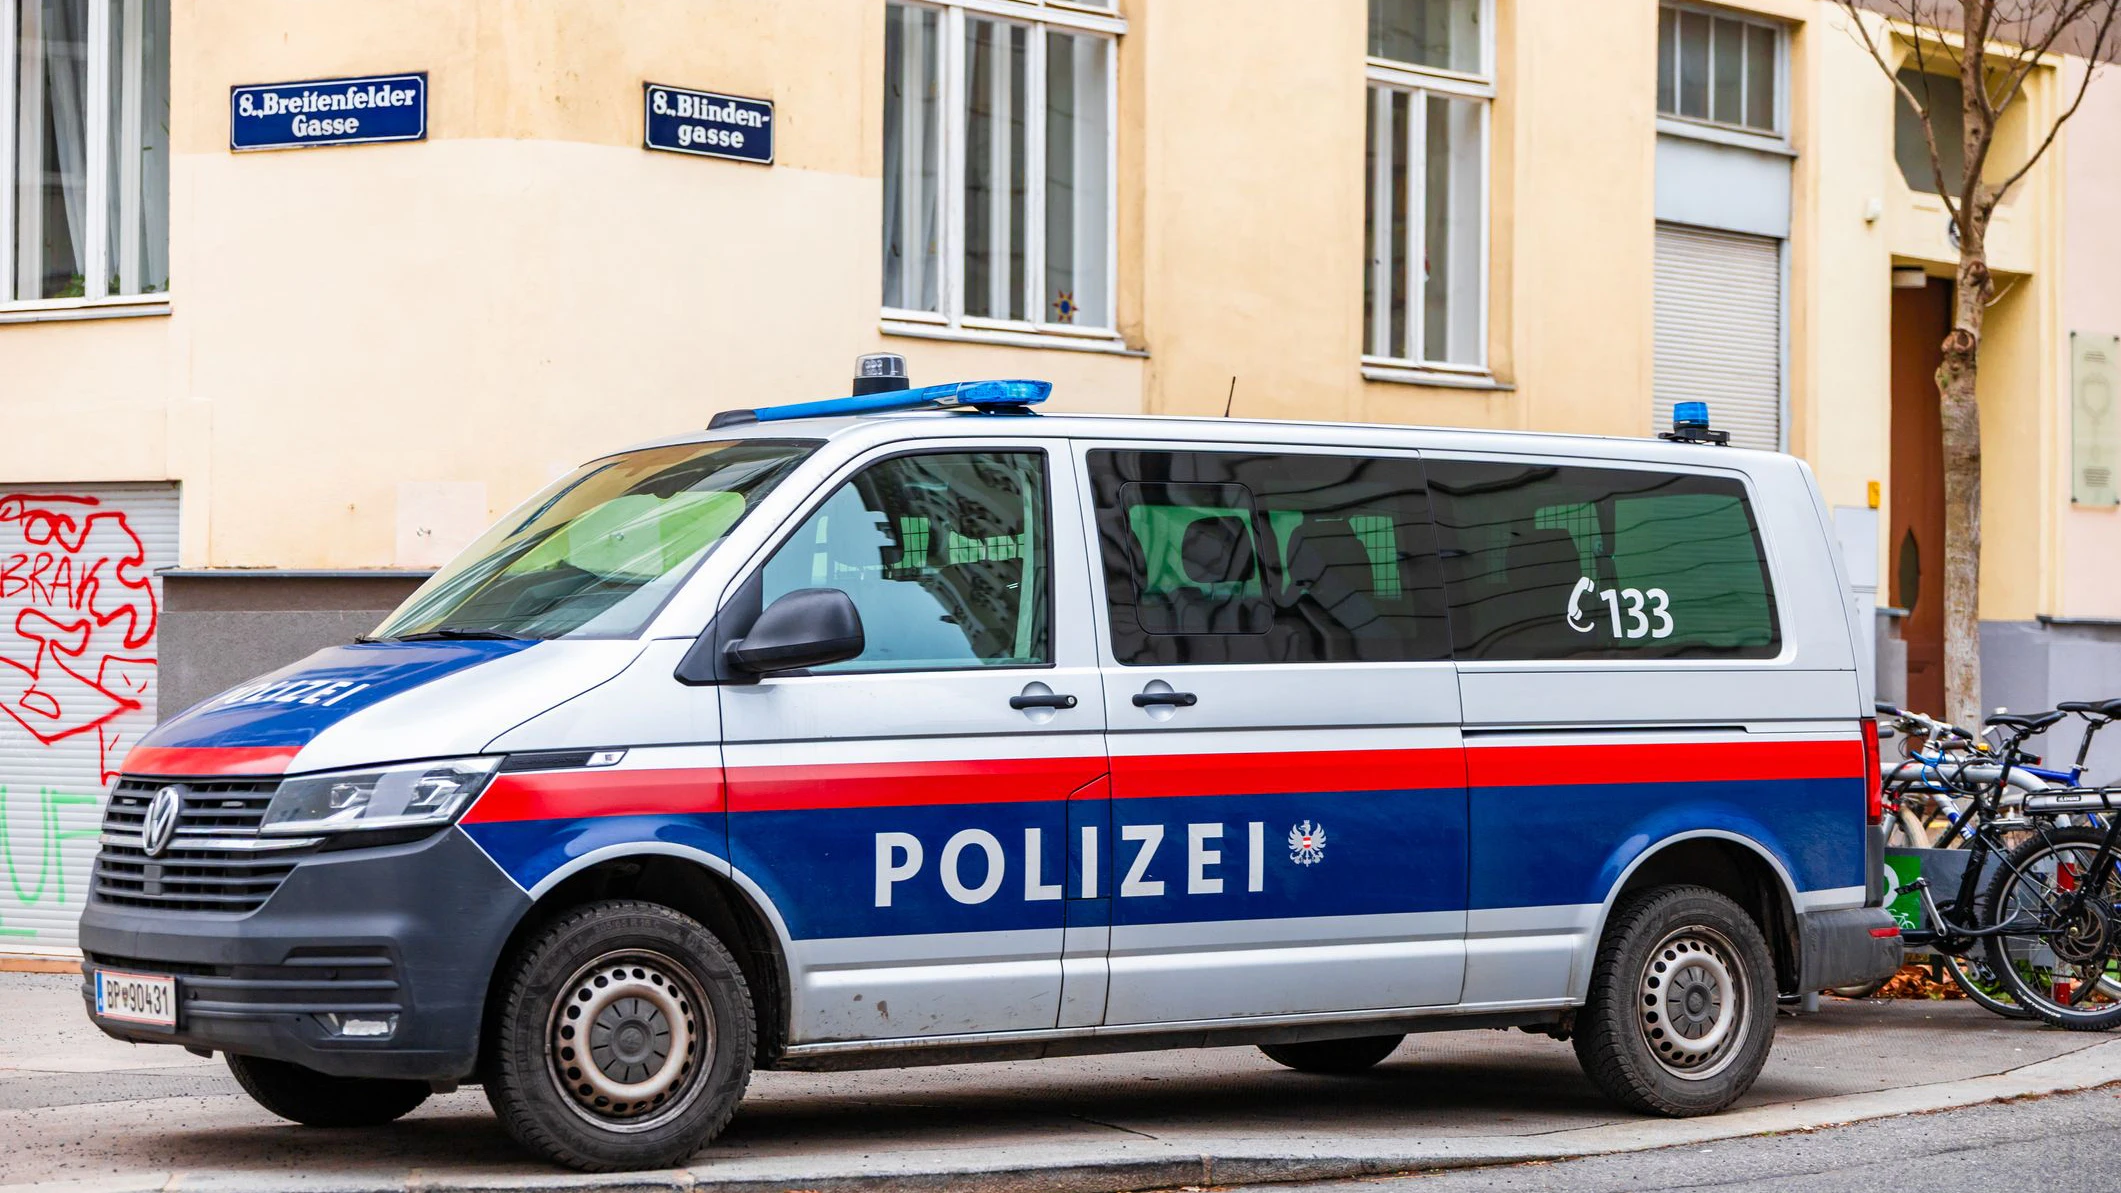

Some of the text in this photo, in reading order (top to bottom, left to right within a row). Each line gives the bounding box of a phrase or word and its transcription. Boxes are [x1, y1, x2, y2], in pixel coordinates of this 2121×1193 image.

[292, 115, 360, 138] Gasse
[677, 124, 745, 149] gasse
[1600, 588, 1674, 638] 133
[875, 821, 1264, 908] POLIZEI
